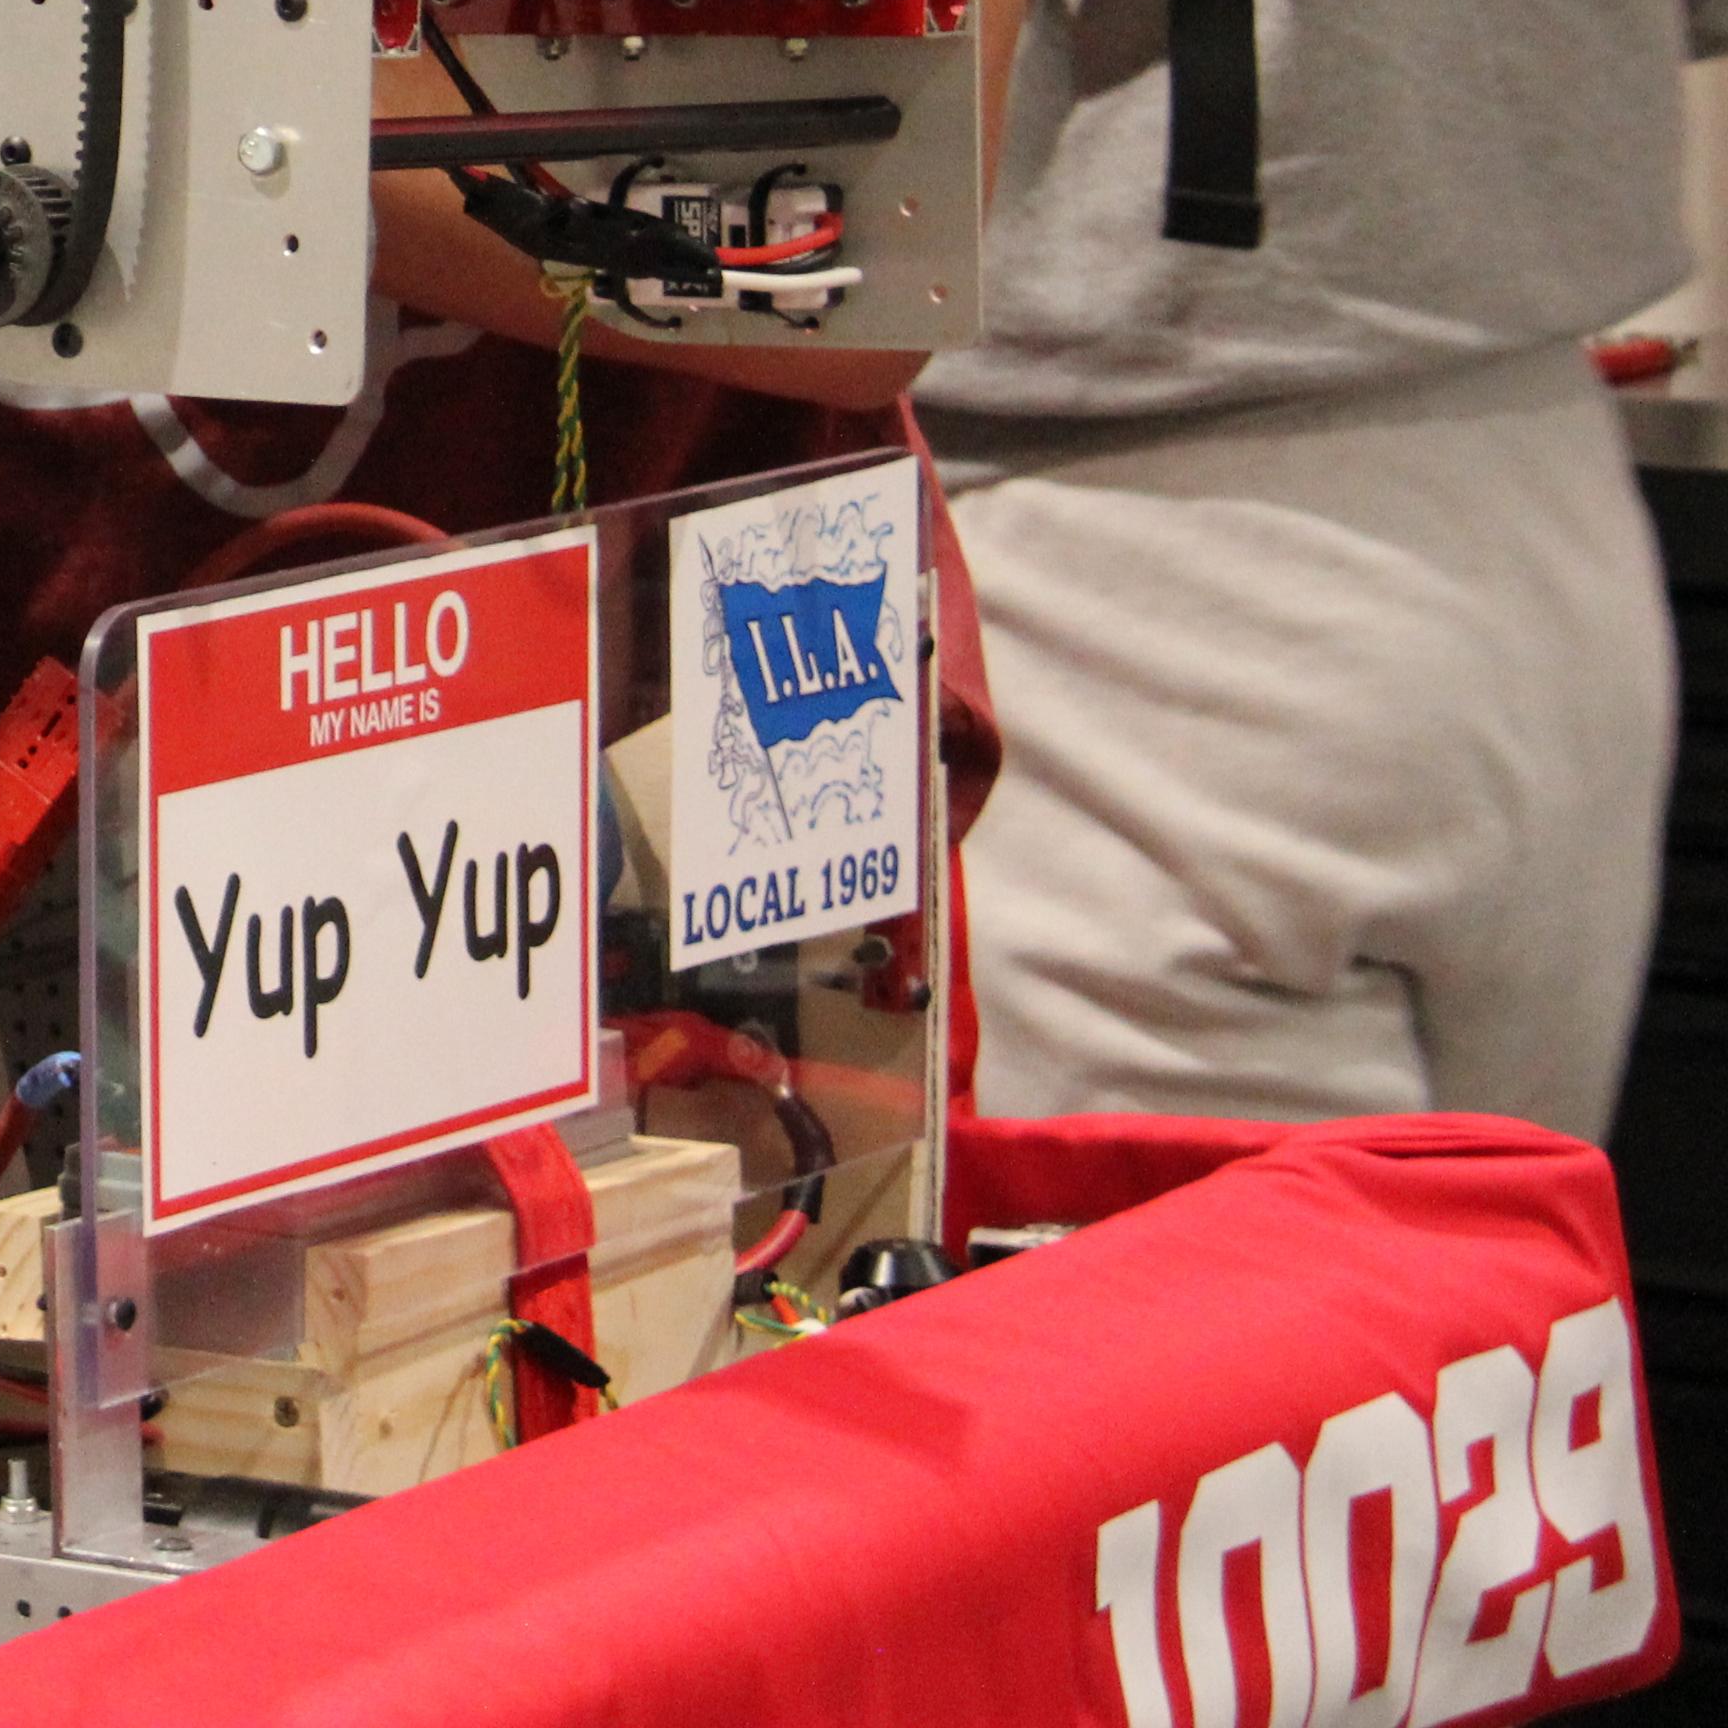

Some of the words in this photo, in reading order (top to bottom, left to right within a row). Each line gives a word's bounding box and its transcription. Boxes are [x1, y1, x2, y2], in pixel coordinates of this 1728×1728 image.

[279, 590, 469, 712] HELLO
[747, 607, 879, 704] I.L.A.
[309, 710, 347, 748] MY
[349, 696, 413, 739] NAME
[417, 689, 440, 725] IS
[175, 872, 350, 1059] Yup
[397, 819, 560, 1000] Yup
[682, 866, 806, 946] LOCAL
[821, 844, 901, 910] 1969
[1096, 1296, 1657, 1728] 10029
